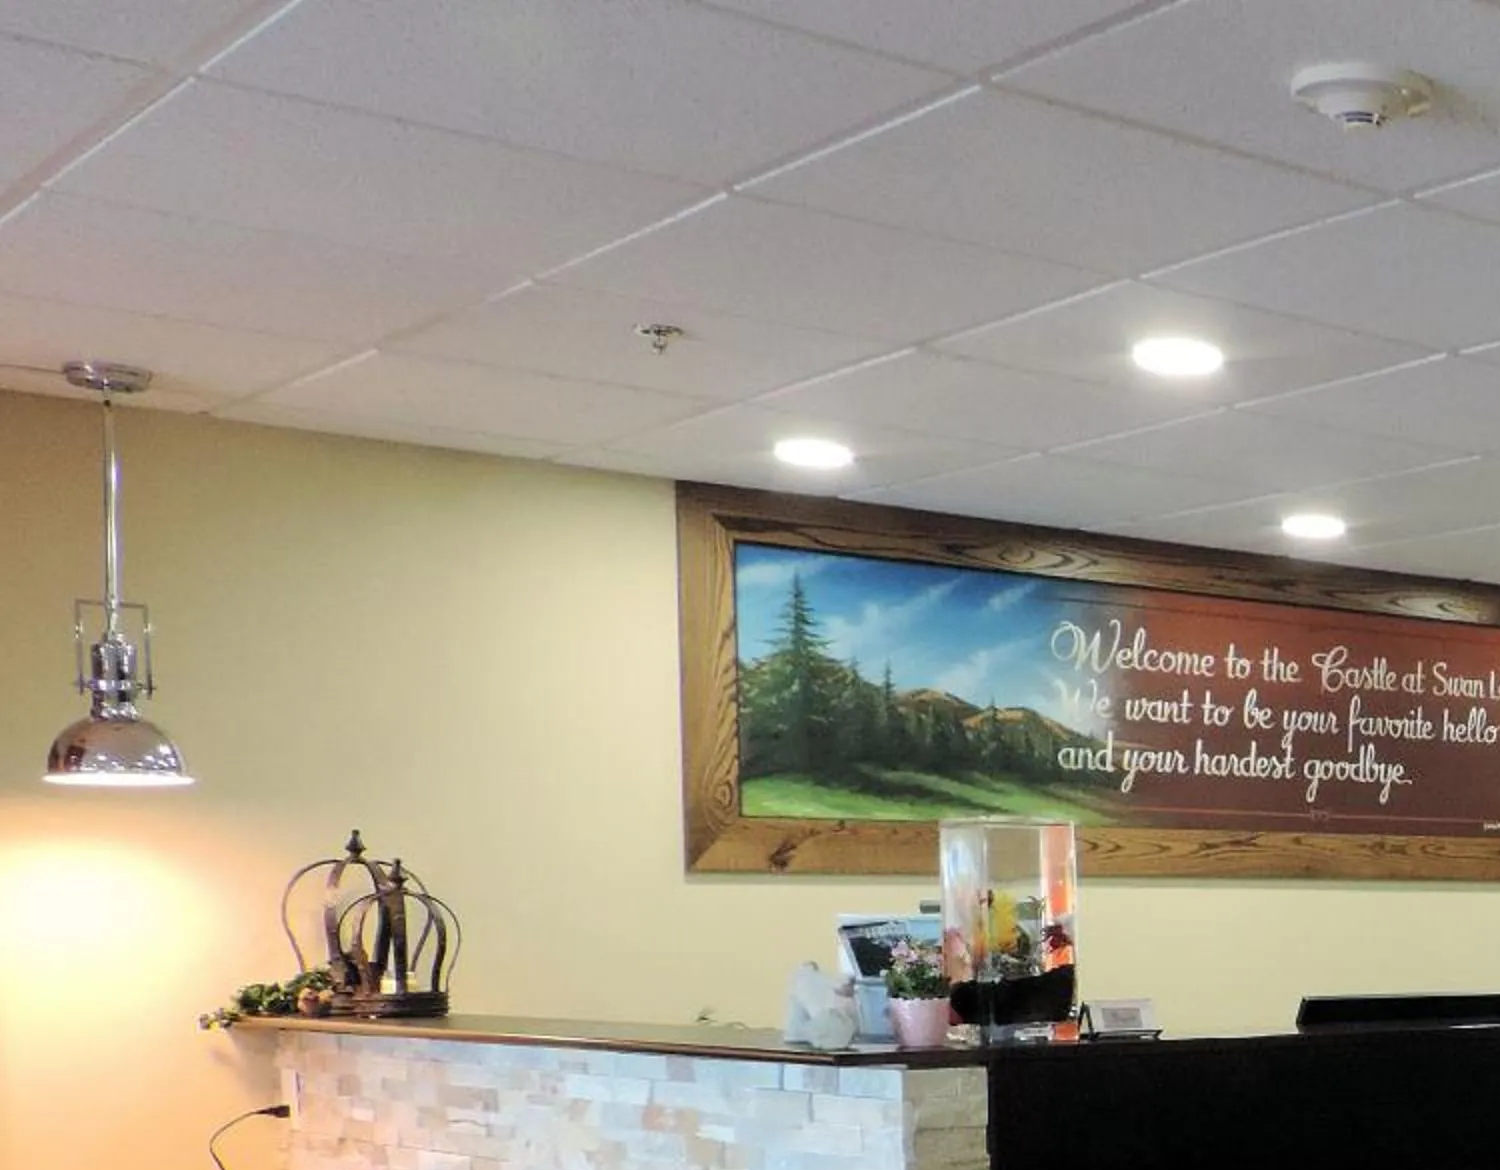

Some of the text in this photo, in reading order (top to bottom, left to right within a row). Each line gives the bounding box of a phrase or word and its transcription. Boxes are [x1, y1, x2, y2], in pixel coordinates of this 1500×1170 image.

[1051, 619, 1215, 677] Welcome
[1224, 643, 1252, 679] to
[1260, 648, 1302, 682] the
[1312, 646, 1398, 693] Castle
[1402, 661, 1425, 694] at
[1432, 662, 1485, 699] Swan
[1053, 679, 1500, 753] We want to be your favorite hello
[1057, 731, 1115, 772] and
[1121, 750, 1190, 793] your
[1193, 739, 1297, 779] hardest
